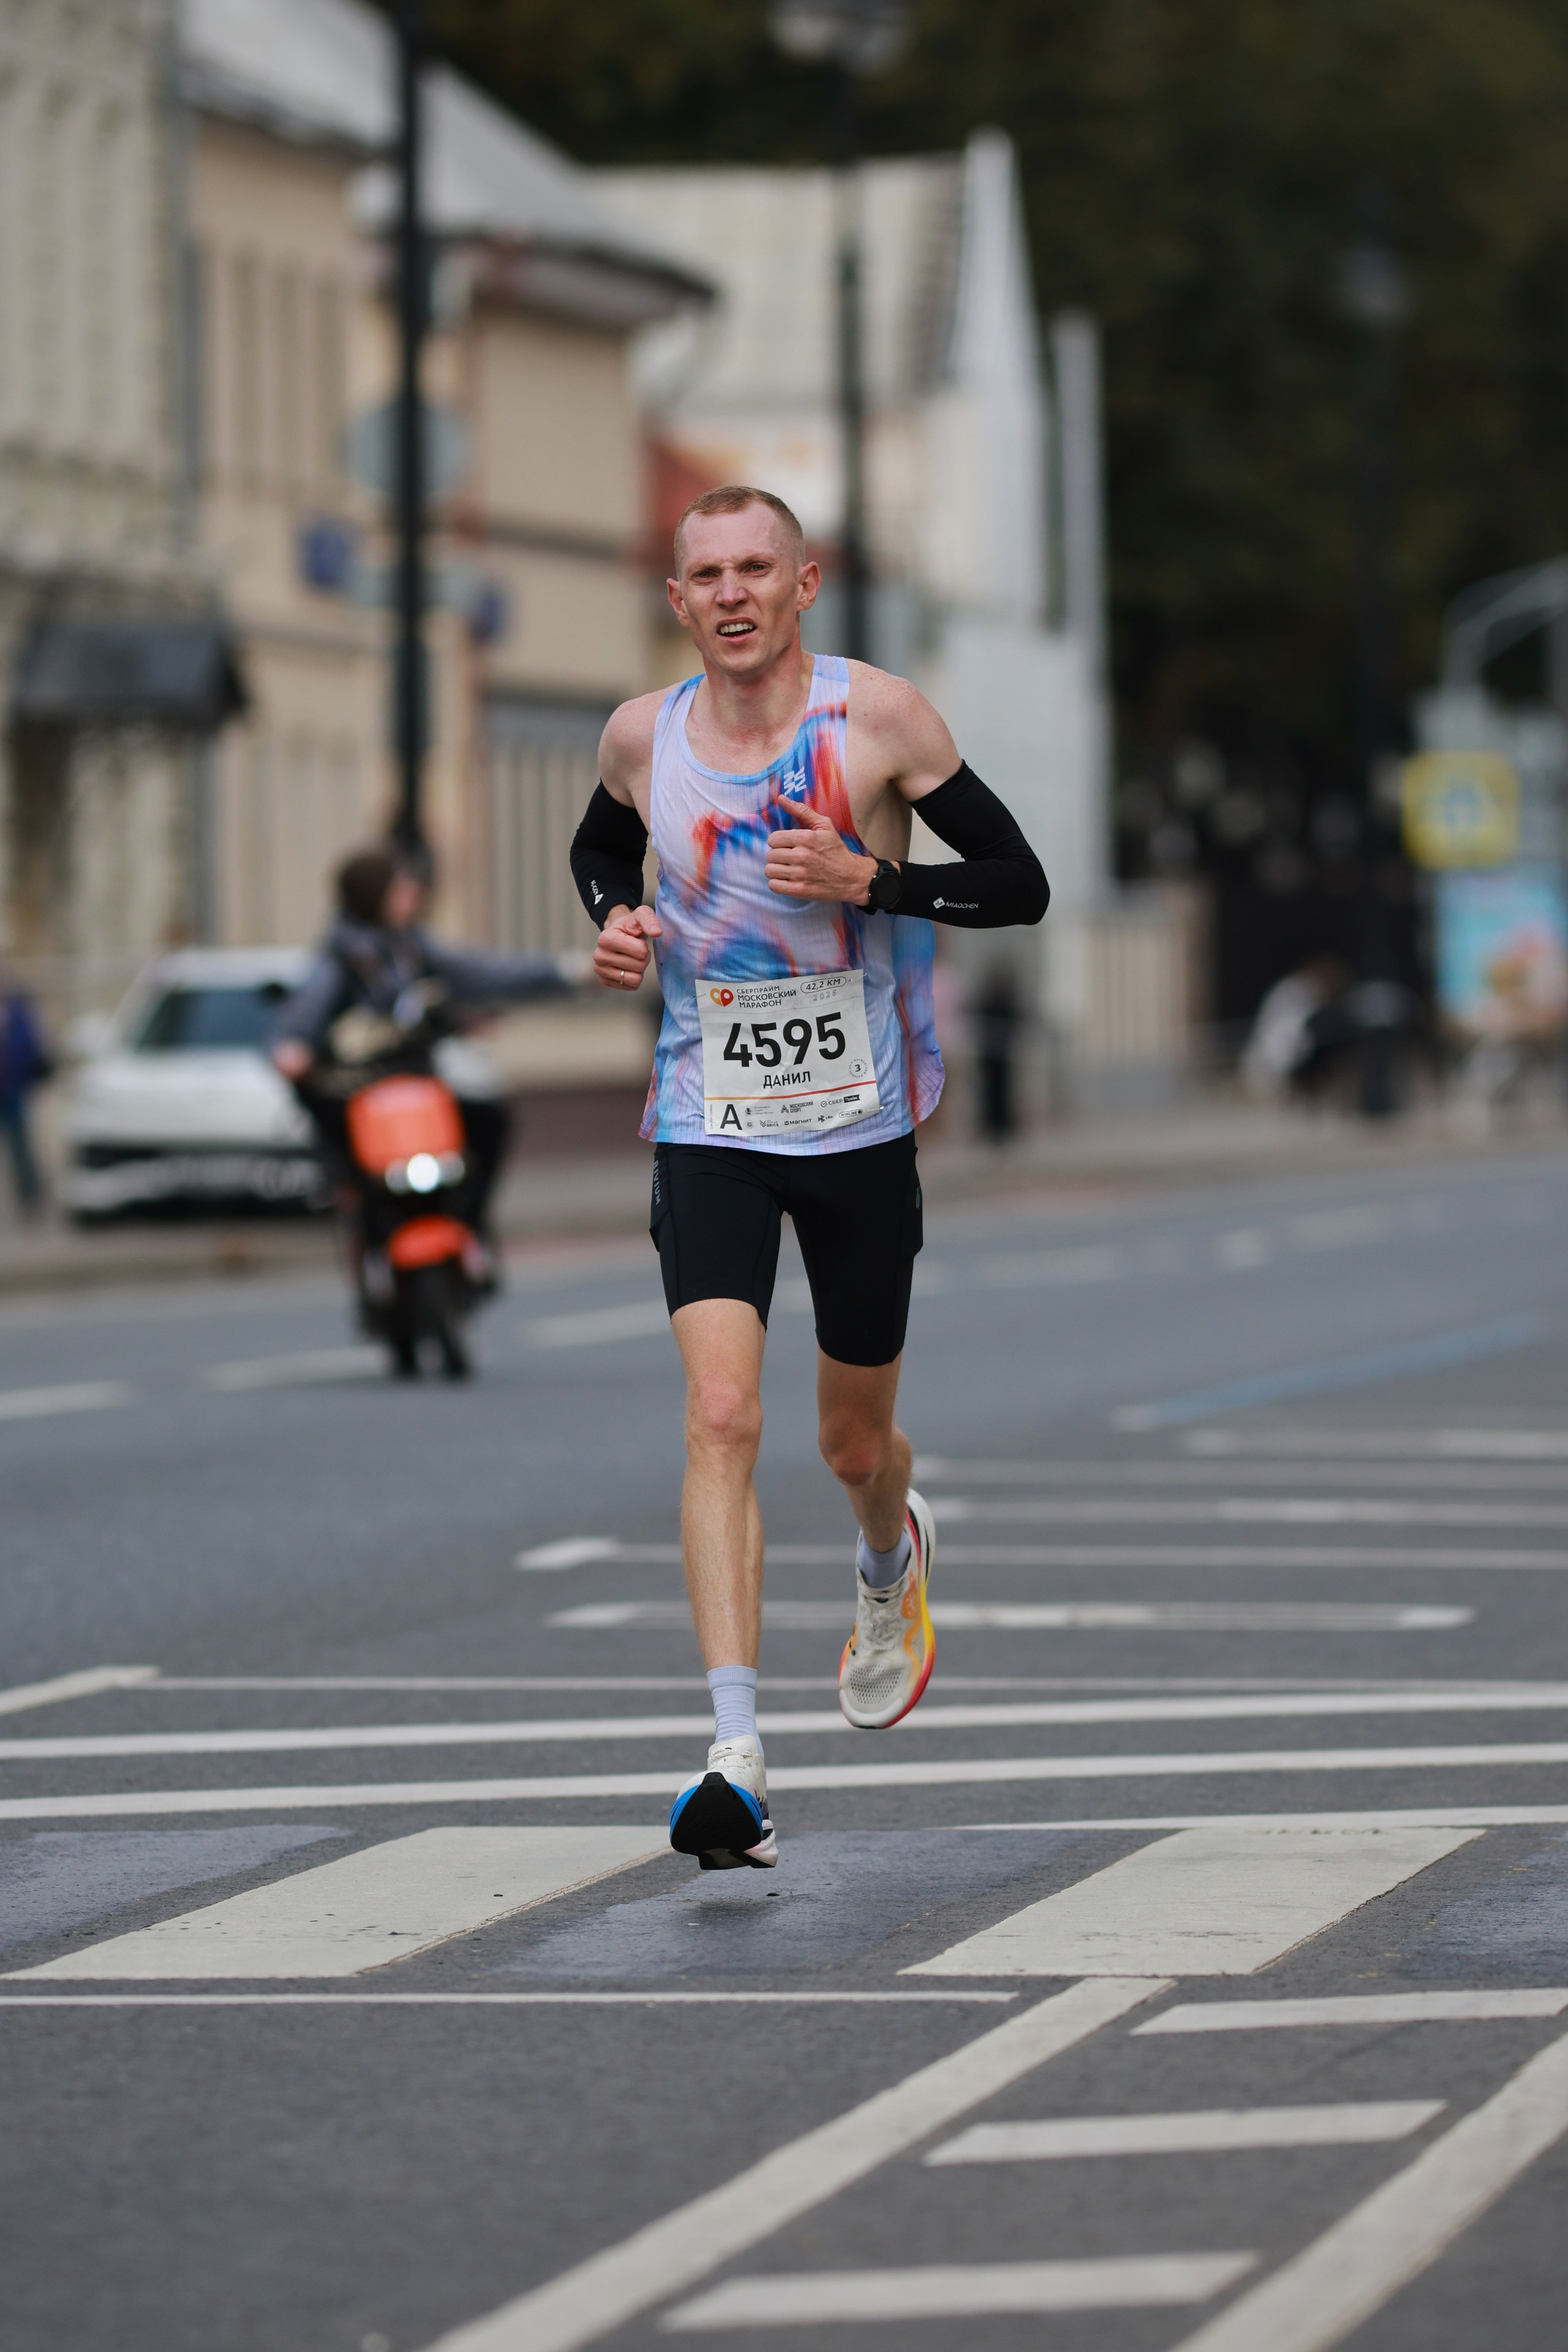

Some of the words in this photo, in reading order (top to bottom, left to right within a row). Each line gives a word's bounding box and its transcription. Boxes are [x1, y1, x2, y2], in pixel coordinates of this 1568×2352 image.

[736, 986, 780, 994] СБЕРПРАЙМ
[805, 981, 824, 990] 42,2
[737, 989, 796, 1001] МОСКОВСКИЙ
[739, 999, 782, 1009] МАРАФОН
[723, 1011, 846, 1068] 4595
[763, 1071, 812, 1089] ДАНИЛ
[789, 1099, 813, 1108] МОСКОВСКИЙ
